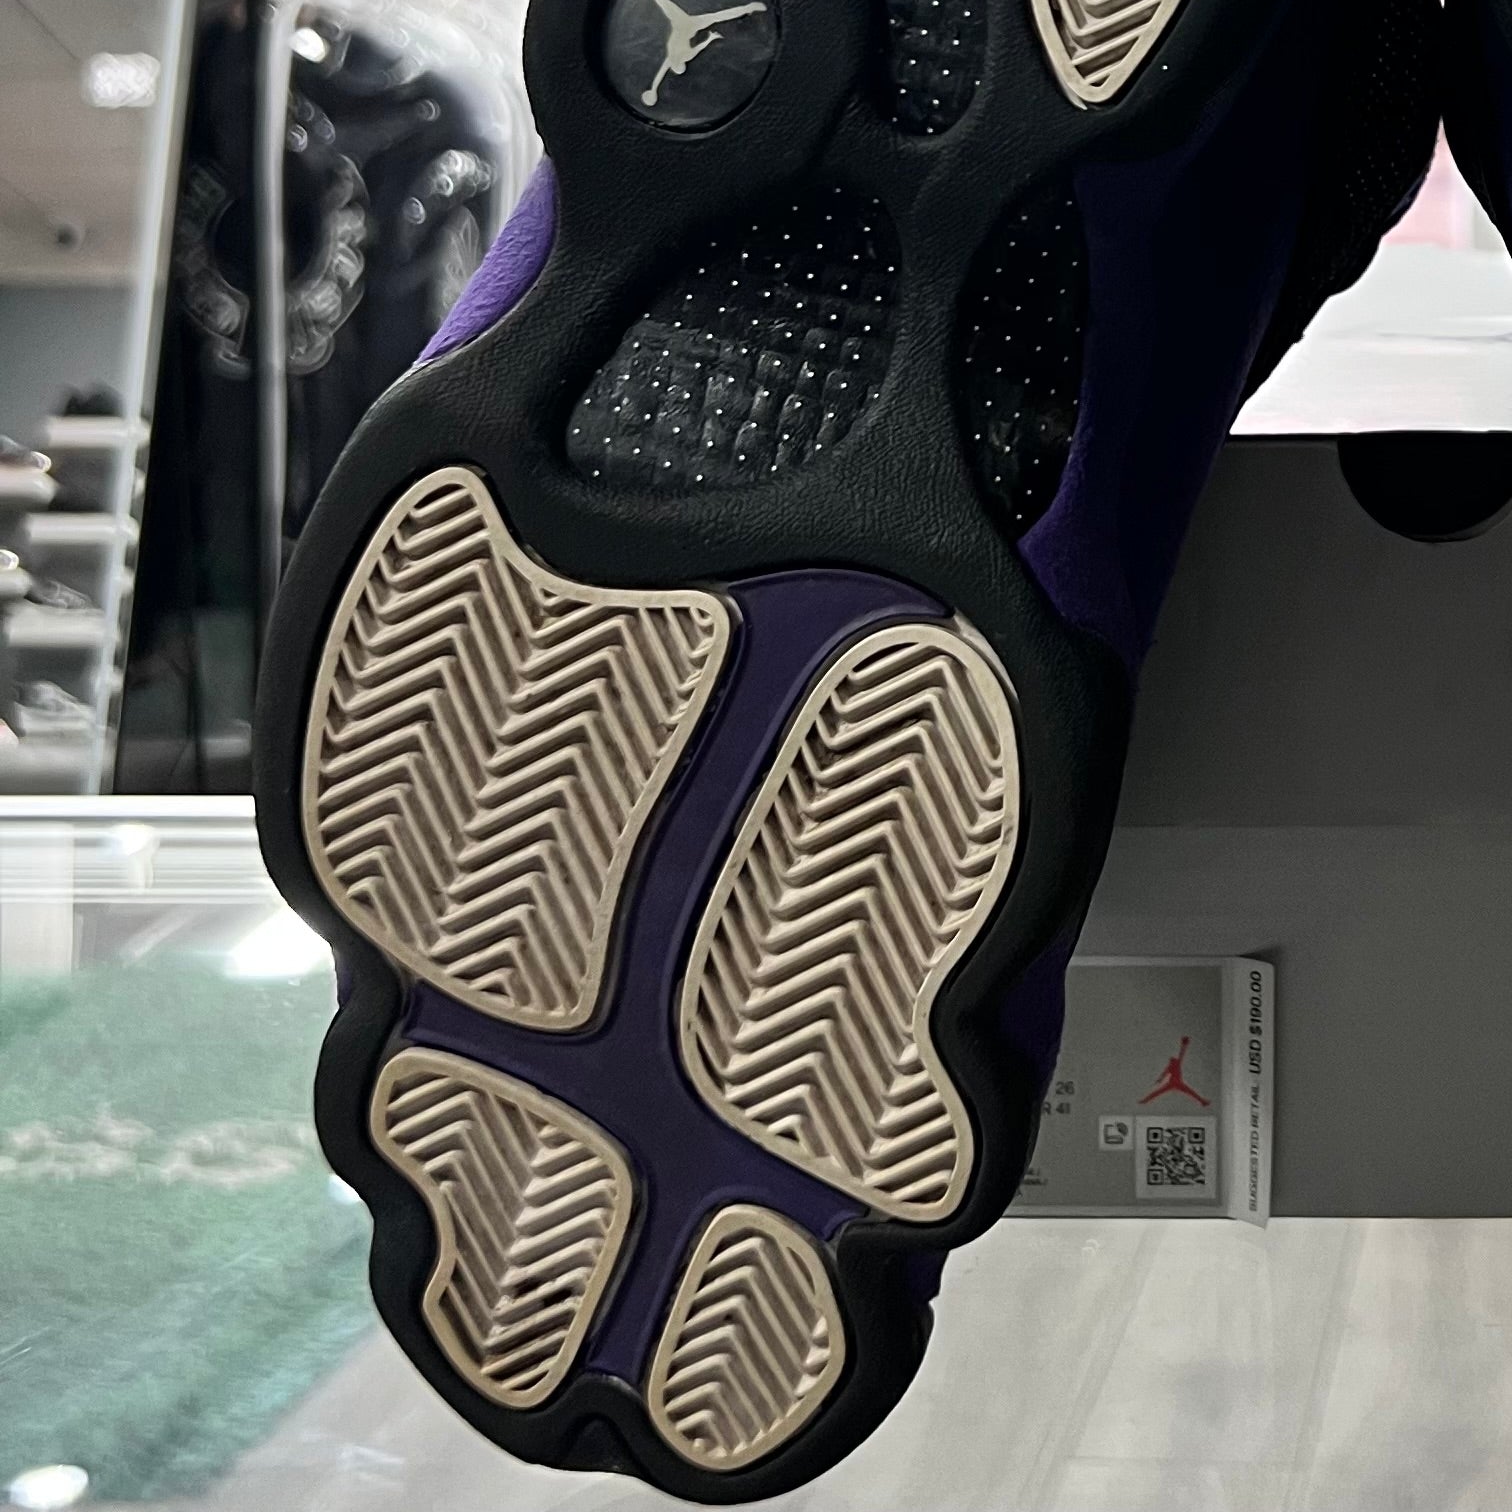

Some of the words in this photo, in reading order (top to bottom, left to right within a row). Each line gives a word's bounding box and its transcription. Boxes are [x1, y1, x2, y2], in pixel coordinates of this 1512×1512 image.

[1249, 970, 1263, 1036] $190.00
[1249, 1040, 1262, 1075] USD
[1055, 1081, 1075, 1095] 26
[1248, 1131, 1259, 1212] SUGGESTED
